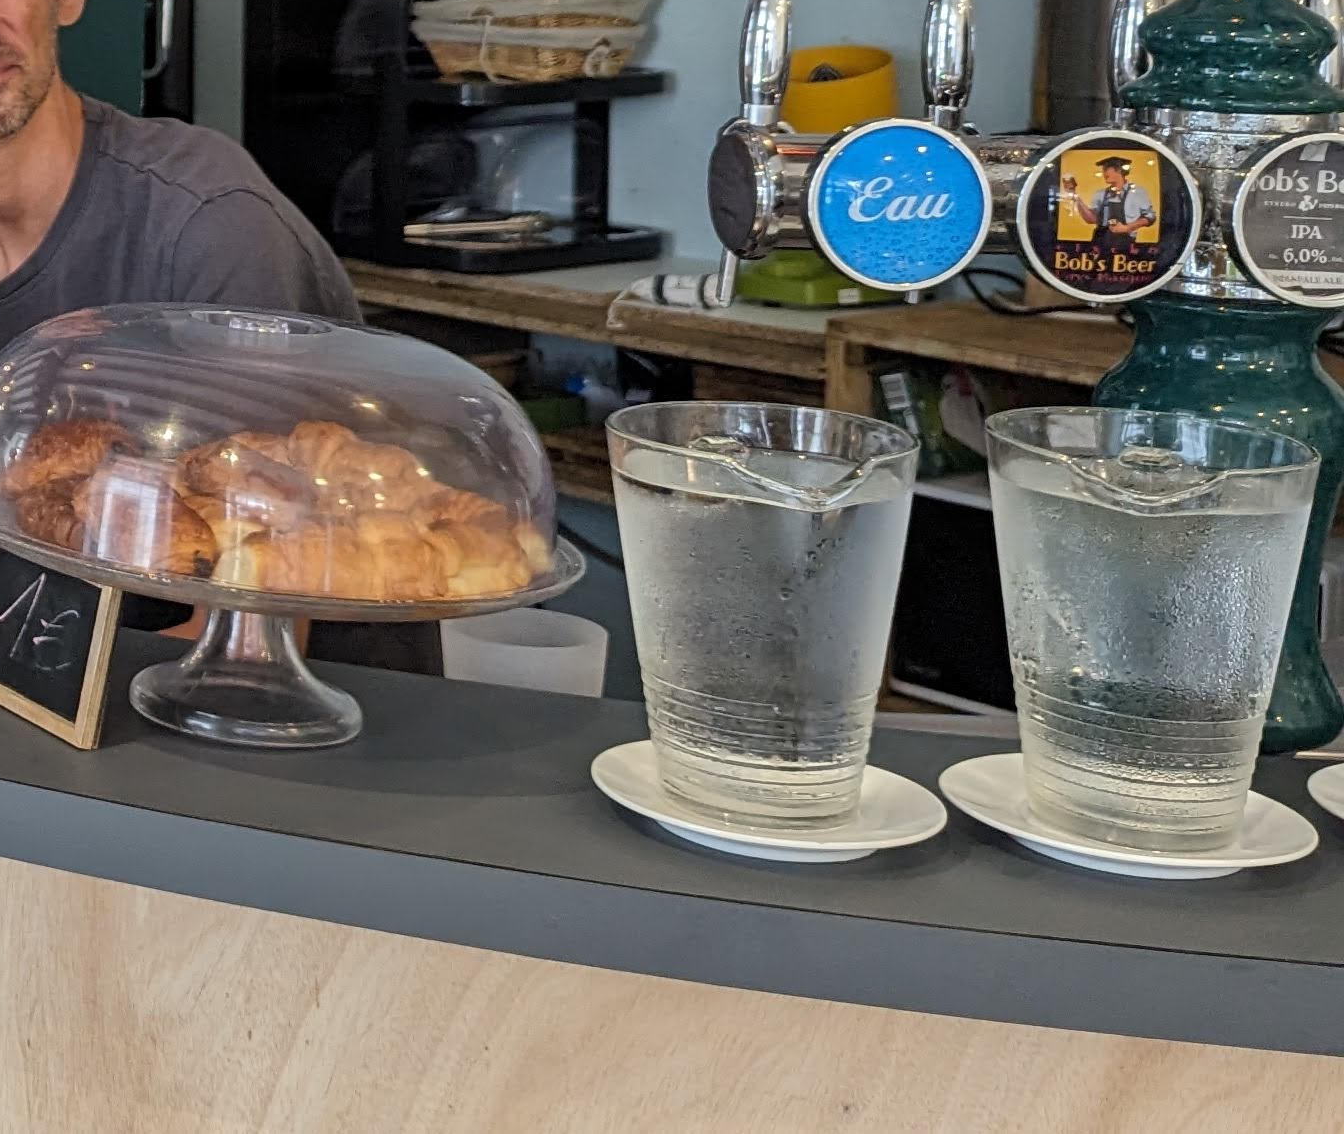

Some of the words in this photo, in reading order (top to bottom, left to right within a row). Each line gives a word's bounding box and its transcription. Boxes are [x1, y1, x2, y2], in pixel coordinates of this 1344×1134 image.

[847, 176, 954, 223] Eau
[1290, 224, 1322, 240] IPA
[1055, 251, 1107, 272] Bob's
[1112, 253, 1157, 273] Beer
[1283, 247, 1328, 264] 6,0%
